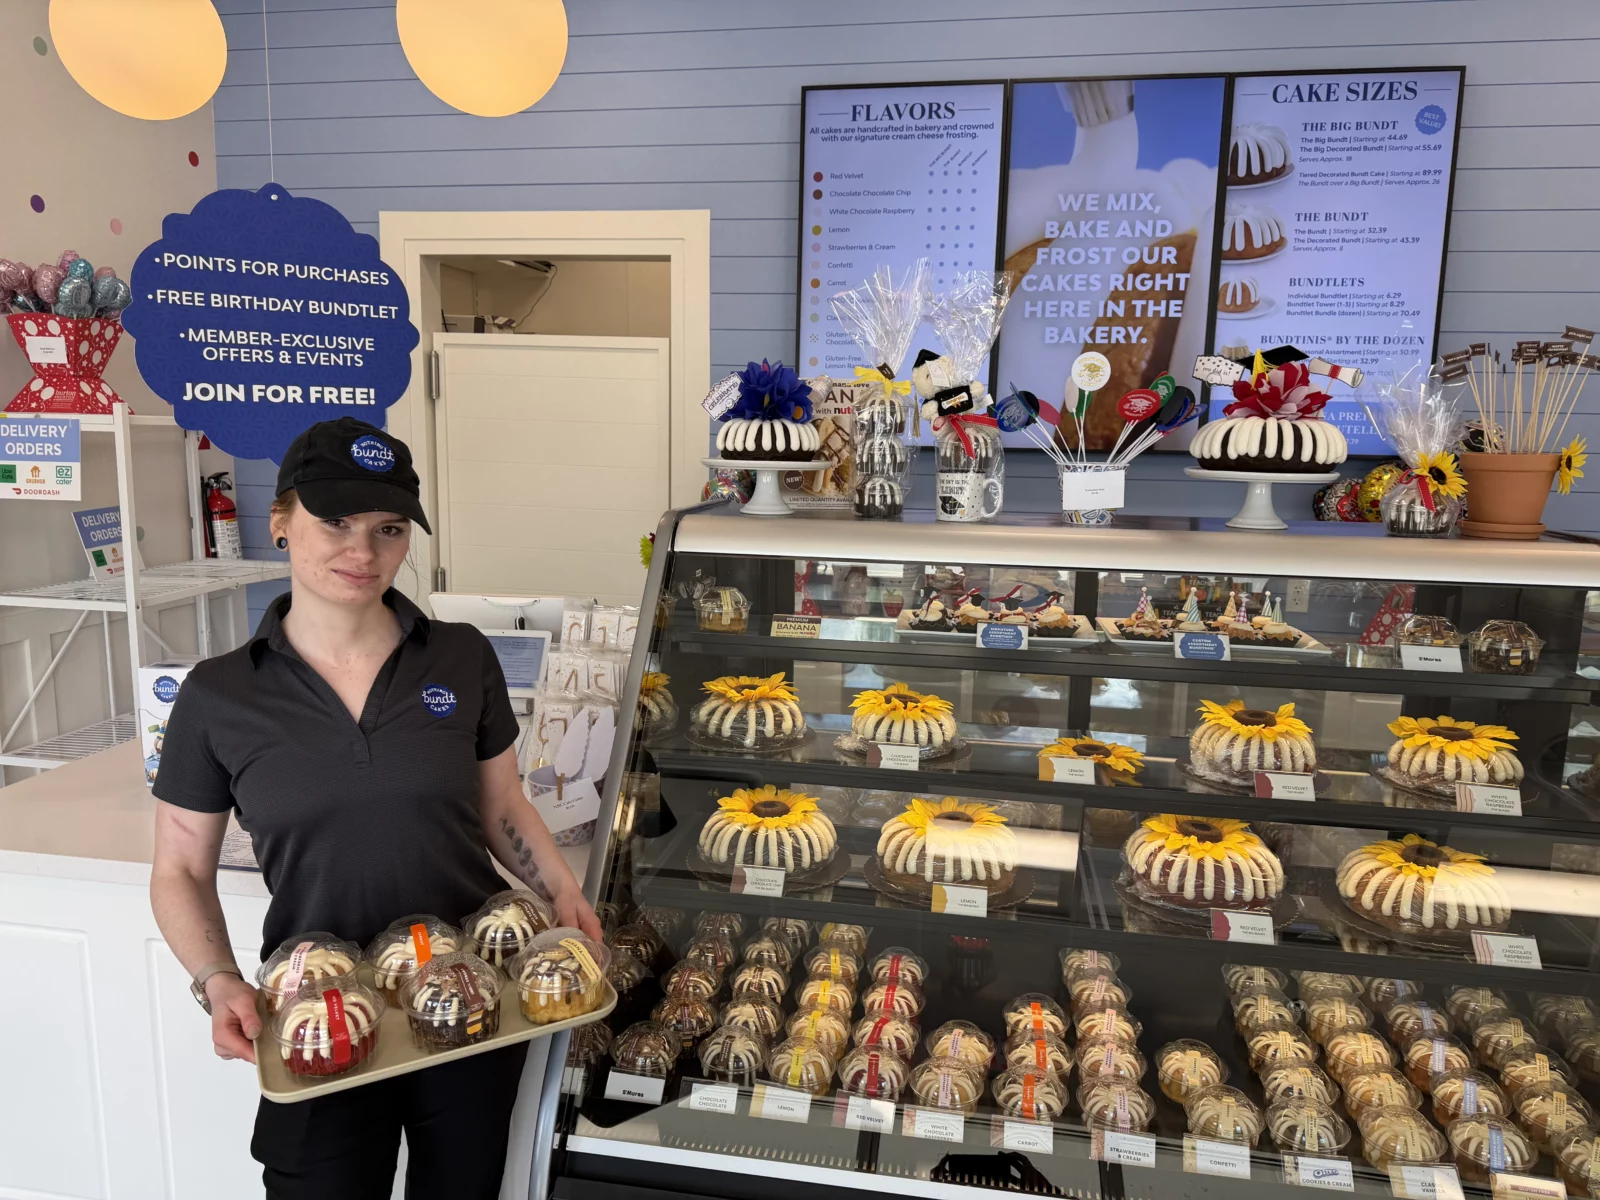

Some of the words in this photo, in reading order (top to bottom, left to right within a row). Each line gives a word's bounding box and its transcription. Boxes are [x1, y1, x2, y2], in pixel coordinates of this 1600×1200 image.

[1272, 82, 1340, 103] CAKE
[1345, 80, 1418, 102] SIZES
[850, 101, 956, 122] FLAVORS
[857, 125, 903, 133] handcrafted
[915, 124, 941, 133] bakery
[959, 122, 994, 130] crowned
[1302, 122, 1327, 131] THE
[1330, 122, 1352, 131] BIG
[1356, 121, 1399, 130] BUNDT
[855, 134, 890, 143] signature
[946, 131, 978, 139] frosting.
[1353, 135, 1378, 143] Starting
[1313, 146, 1324, 154] Big
[1387, 144, 1413, 152] Starting
[1058, 193, 1099, 211] WE
[1107, 193, 1161, 214] MIX,
[1295, 212, 1321, 221] THE
[1324, 212, 1369, 221] BUNDT
[1045, 220, 1109, 238] BAKE
[1115, 220, 1172, 238] AND
[1036, 247, 1116, 265] FROST
[1121, 247, 1177, 264] OUR
[163, 253, 236, 273] POINTS
[241, 260, 279, 277] FOR
[284, 264, 389, 285] PURCHASES
[1021, 274, 1102, 292] CAKES
[1109, 274, 1190, 291] RIGHT
[1289, 277, 1365, 287] BUNDTLETS
[157, 289, 205, 306] FREE
[211, 293, 304, 313] BIRTHDAY
[308, 301, 399, 319] BUNDTLET
[1024, 301, 1091, 318] HERE
[1099, 300, 1125, 317] IN
[1132, 300, 1183, 317] THE
[188, 328, 375, 351] MEMBER-EXCLUSIVE
[1044, 327, 1147, 344] BAKERY.
[1336, 335, 1353, 345] BY
[1356, 336, 1386, 345] THE
[1389, 336, 1425, 345] DOZEN
[203, 347, 274, 363] OFFERS
[279, 351, 291, 364] &
[296, 352, 363, 367] EVENTS
[183, 382, 245, 402] JOIN
[252, 385, 304, 403] FOR
[310, 387, 375, 405] FREE!
[1, 424, 68, 437] DELIVERY
[5, 443, 62, 455] ORDERS
[351, 444, 395, 461] bundt
[58, 468, 70, 476] ez
[777, 623, 816, 631] BANANA
[422, 691, 456, 703] bundt
[924, 1129, 954, 1137] CHOCOLATE
[1110, 1147, 1149, 1157] STRAWBERRIES
[1210, 1160, 1237, 1168] CONFETTI
